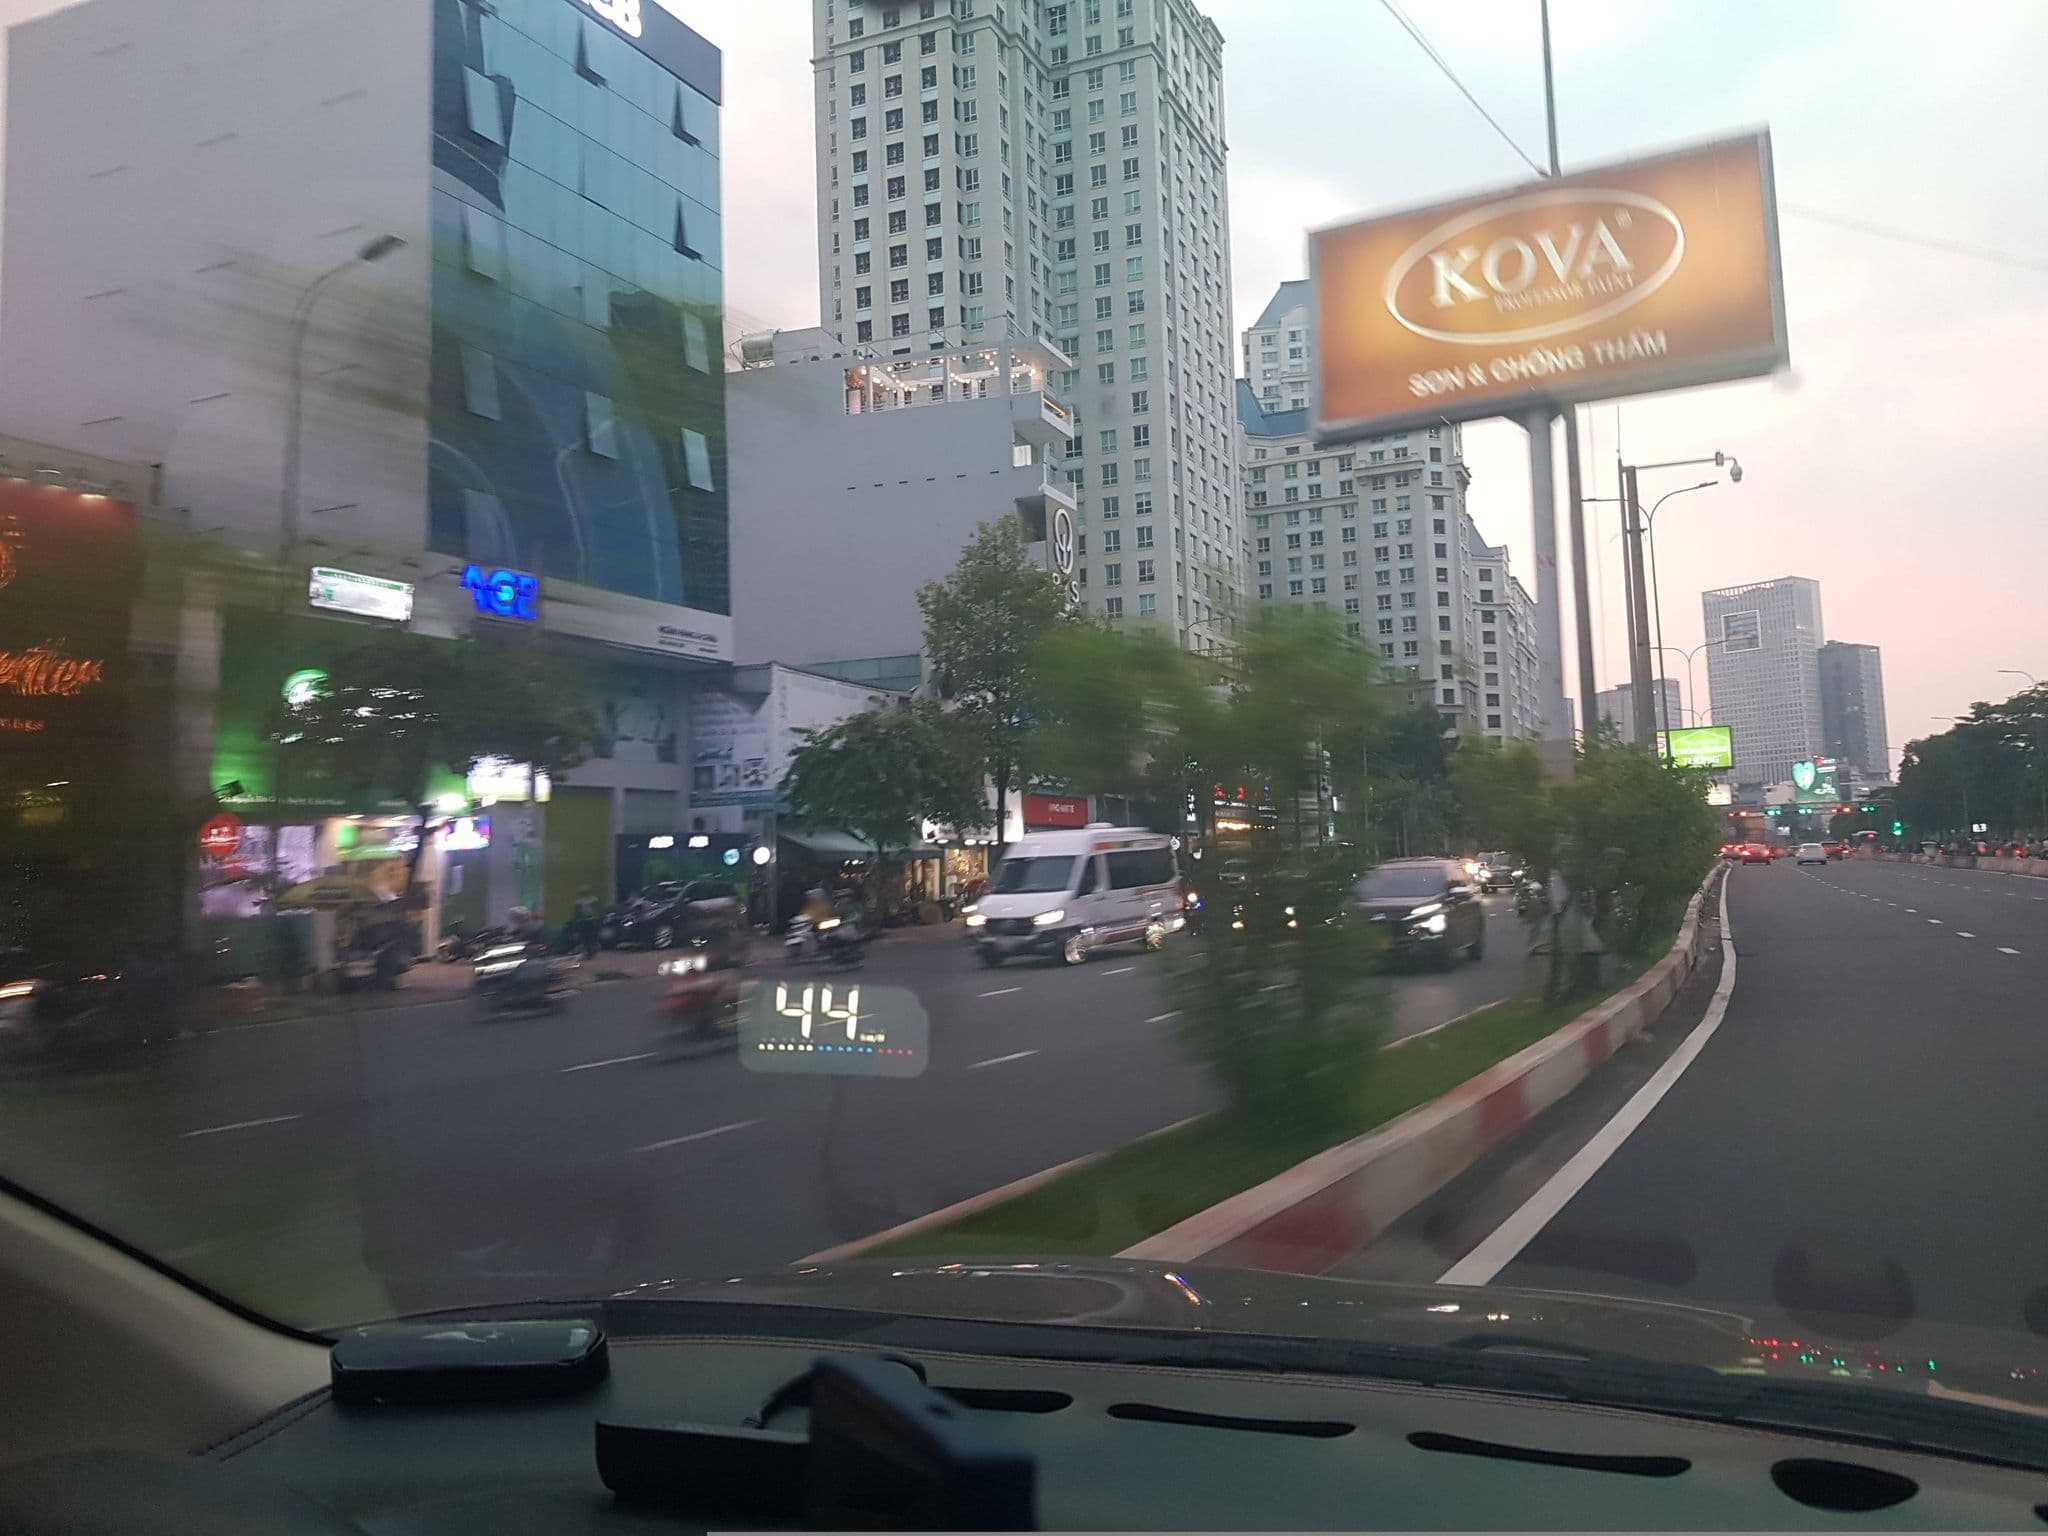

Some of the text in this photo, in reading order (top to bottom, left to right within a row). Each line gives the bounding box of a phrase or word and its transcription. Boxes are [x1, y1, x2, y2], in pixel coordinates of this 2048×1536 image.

[1428, 217, 1634, 308] KOVA
[1467, 361, 1488, 387] &
[776, 983, 859, 1040] 44
